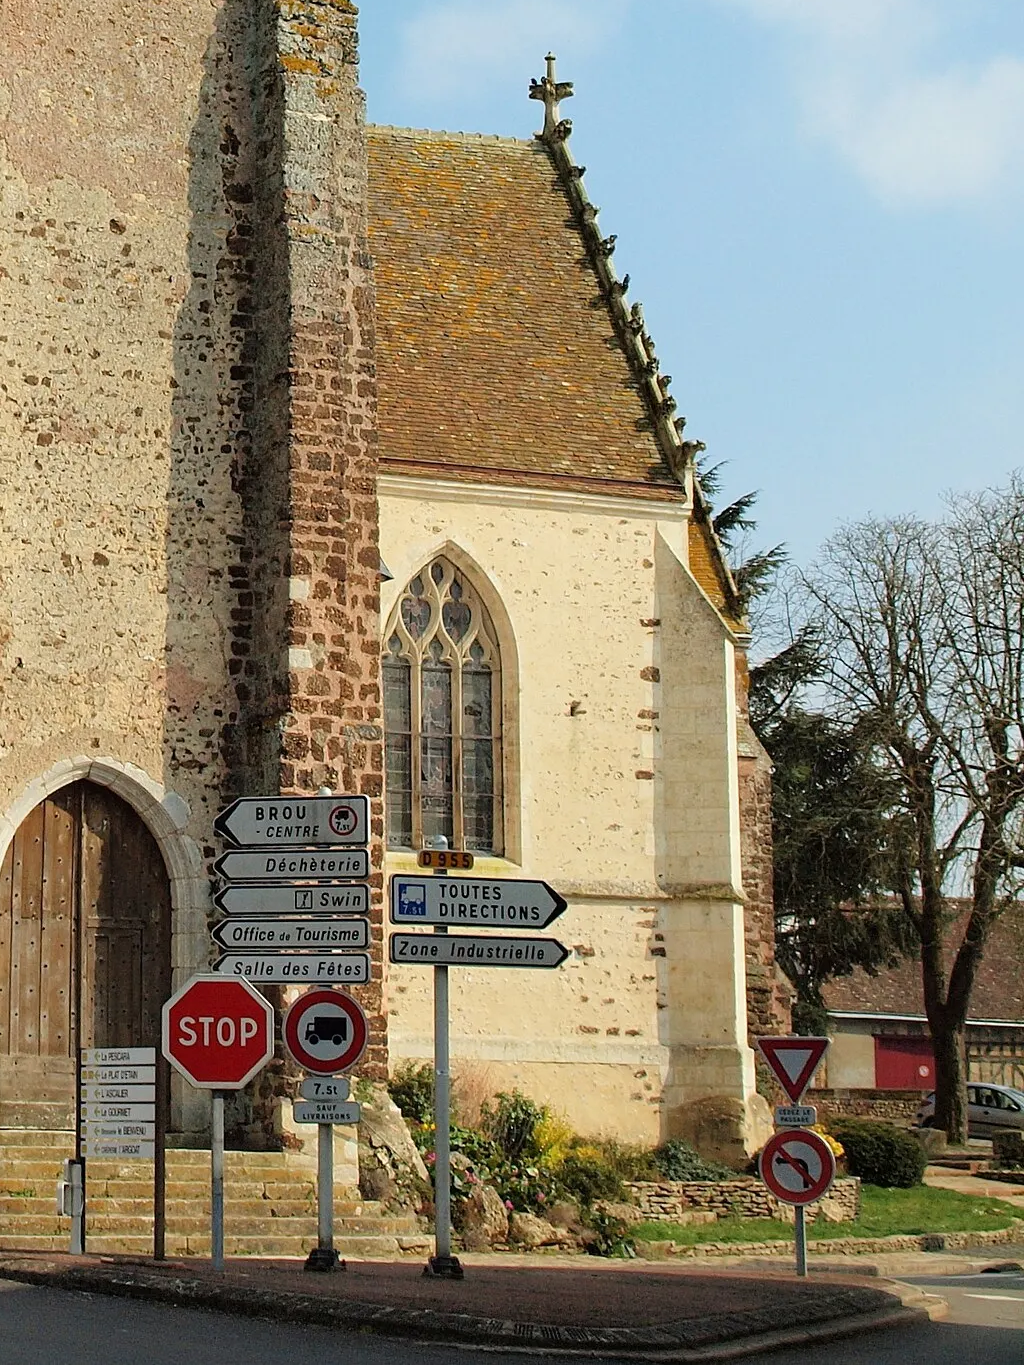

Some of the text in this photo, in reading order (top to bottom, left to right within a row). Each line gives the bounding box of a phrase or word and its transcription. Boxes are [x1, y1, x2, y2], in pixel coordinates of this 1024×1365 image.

[255, 806, 306, 821] BROU
[266, 825, 319, 838] CENTRE
[266, 857, 361, 873] Déchèterie
[422, 852, 470, 869] D 955
[319, 891, 361, 907] Swin
[439, 884, 502, 901] TOUTES
[439, 902, 540, 921] DIRECTIONS
[232, 926, 360, 942] Office de Tourisme
[398, 941, 545, 961] Zone Industrielle
[233, 961, 362, 976] Salle des Fêtes
[178, 1016, 258, 1047] STOP
[313, 1082, 338, 1095] 7.5t
[316, 1104, 337, 1112] SAUF
